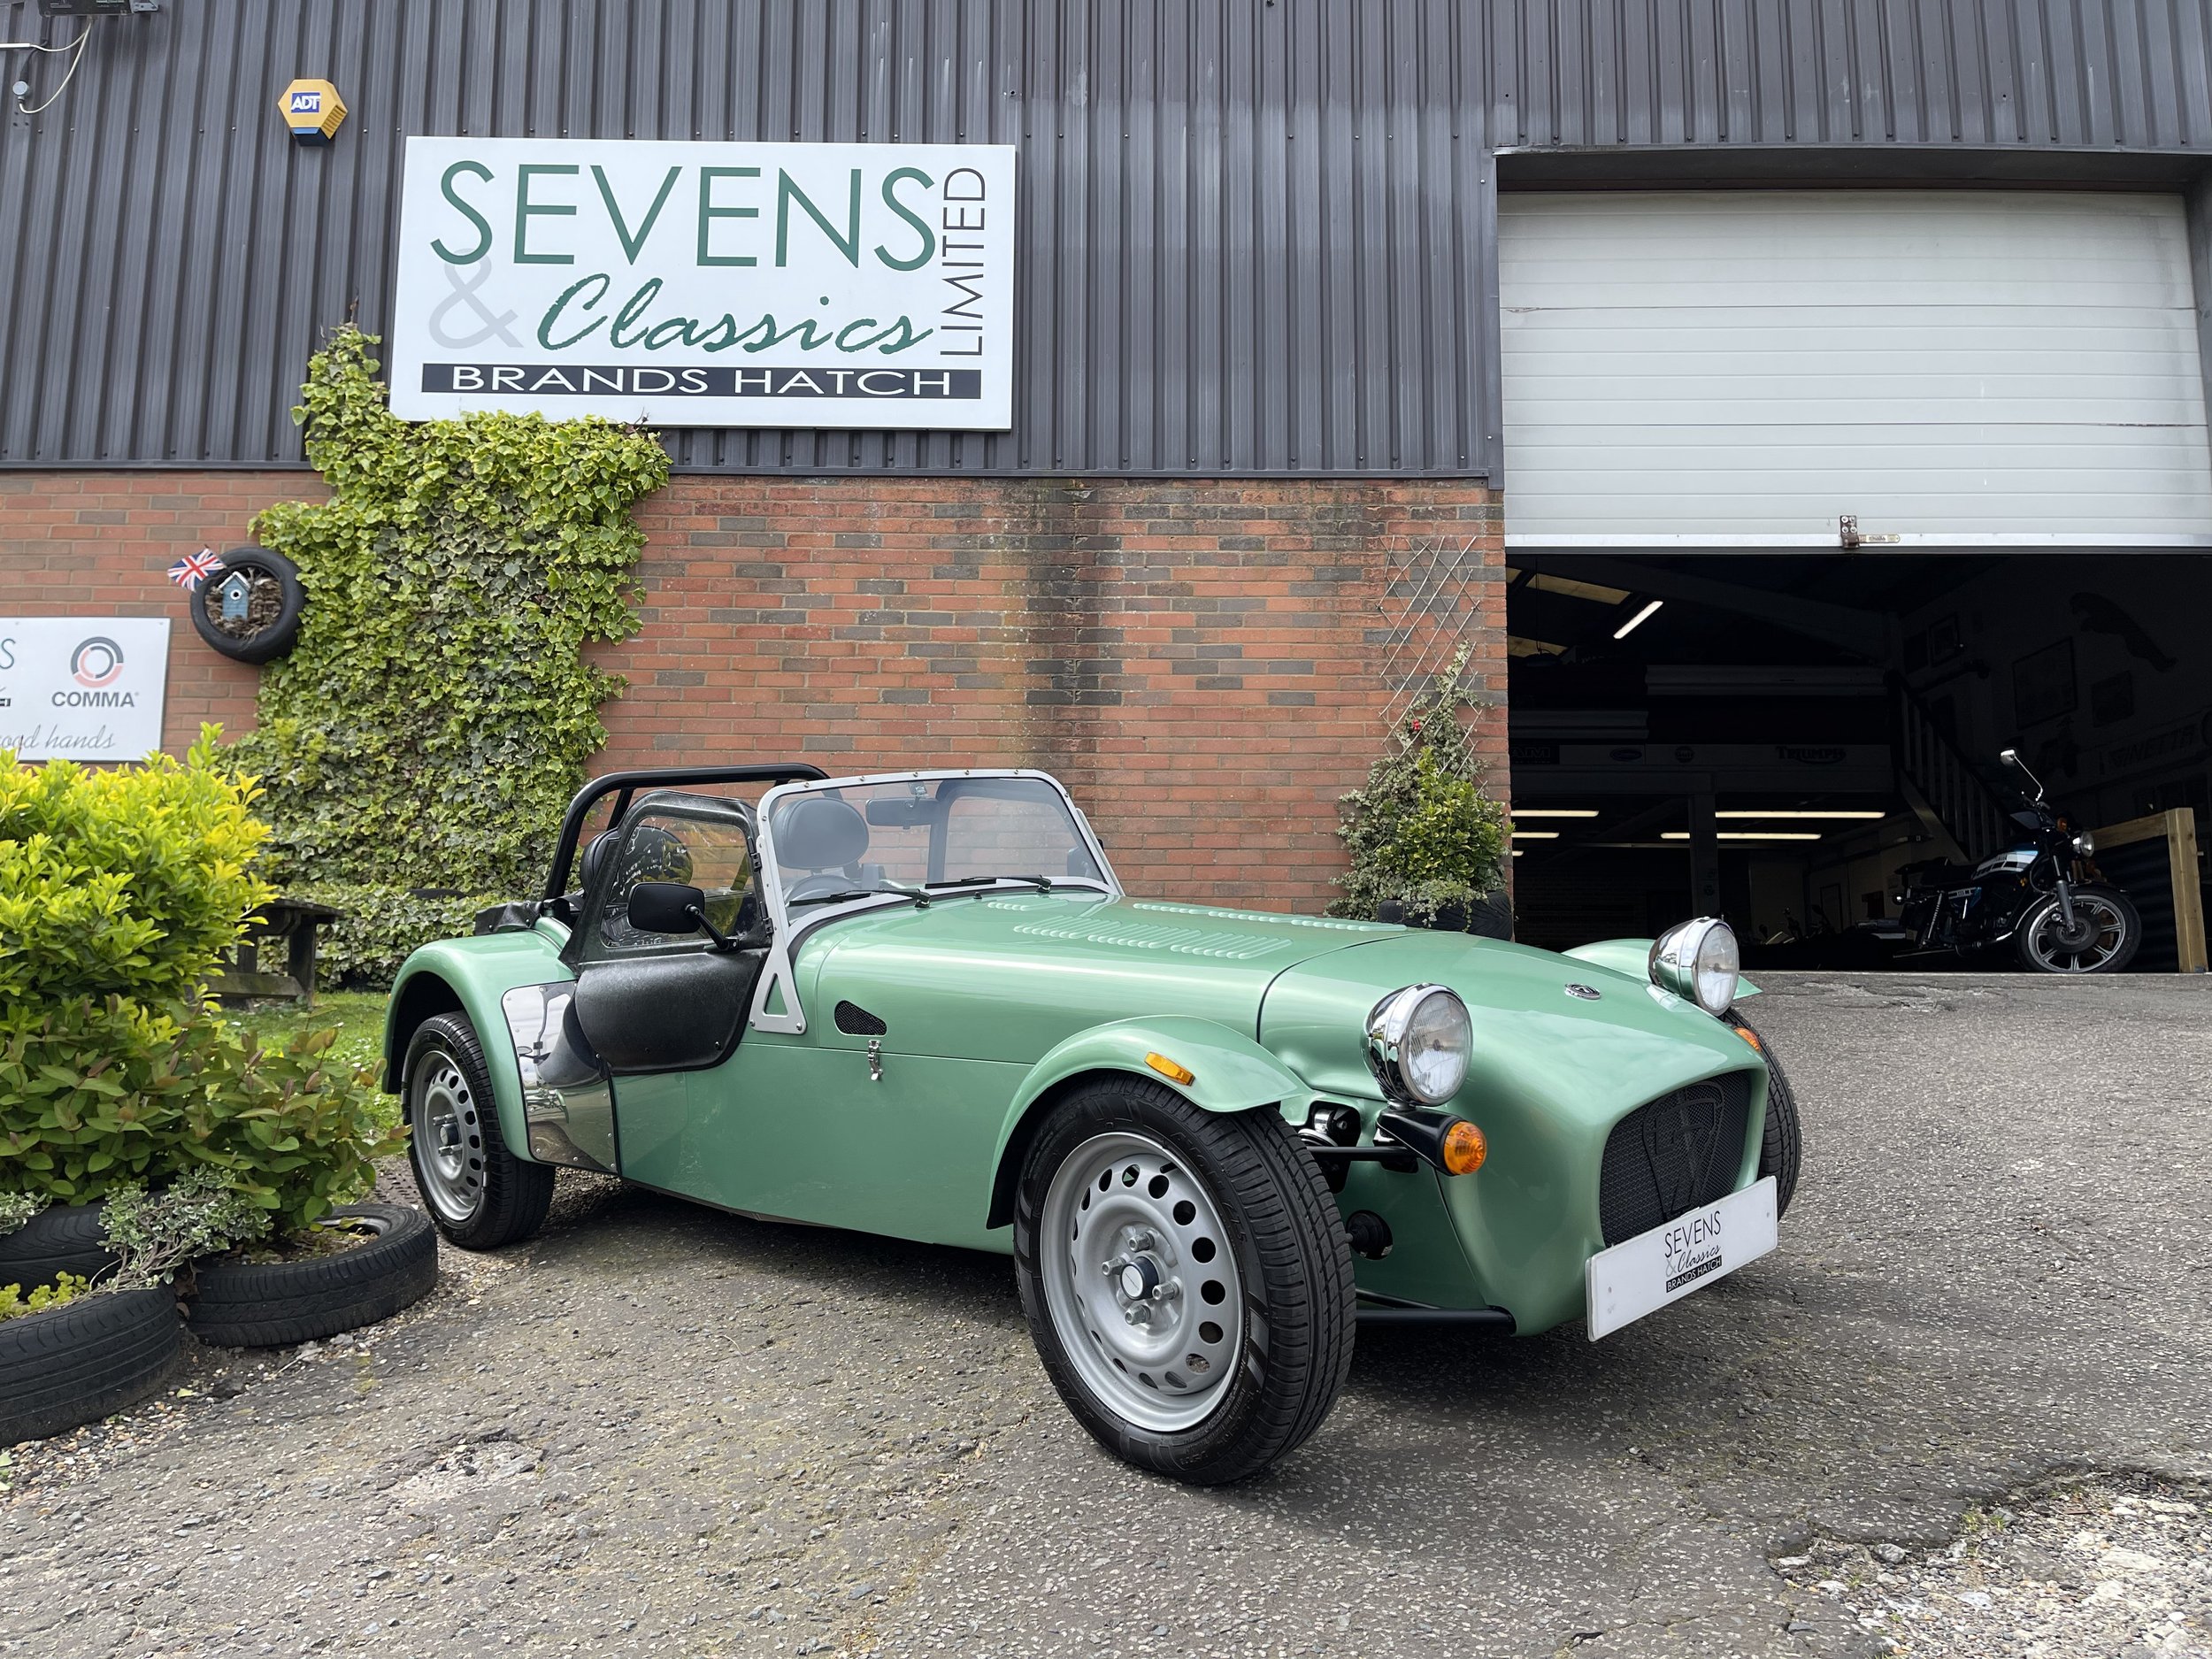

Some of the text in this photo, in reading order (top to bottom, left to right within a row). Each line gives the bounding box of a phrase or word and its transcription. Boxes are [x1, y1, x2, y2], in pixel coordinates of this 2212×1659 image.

[291, 95, 321, 111] ADT
[430, 160, 936, 271] SEVENS
[940, 167, 986, 356] LIMITED
[428, 249, 933, 354] & Classics
[452, 365, 951, 396] BRANDS HATCH
[51, 691, 134, 708] COMMA
[0, 724, 116, 749] ood hands
[1664, 1210, 1721, 1258] SEVENS
[1667, 1257, 1722, 1292] BRANDS HATCH
[1678, 1245, 1722, 1273] Classics
